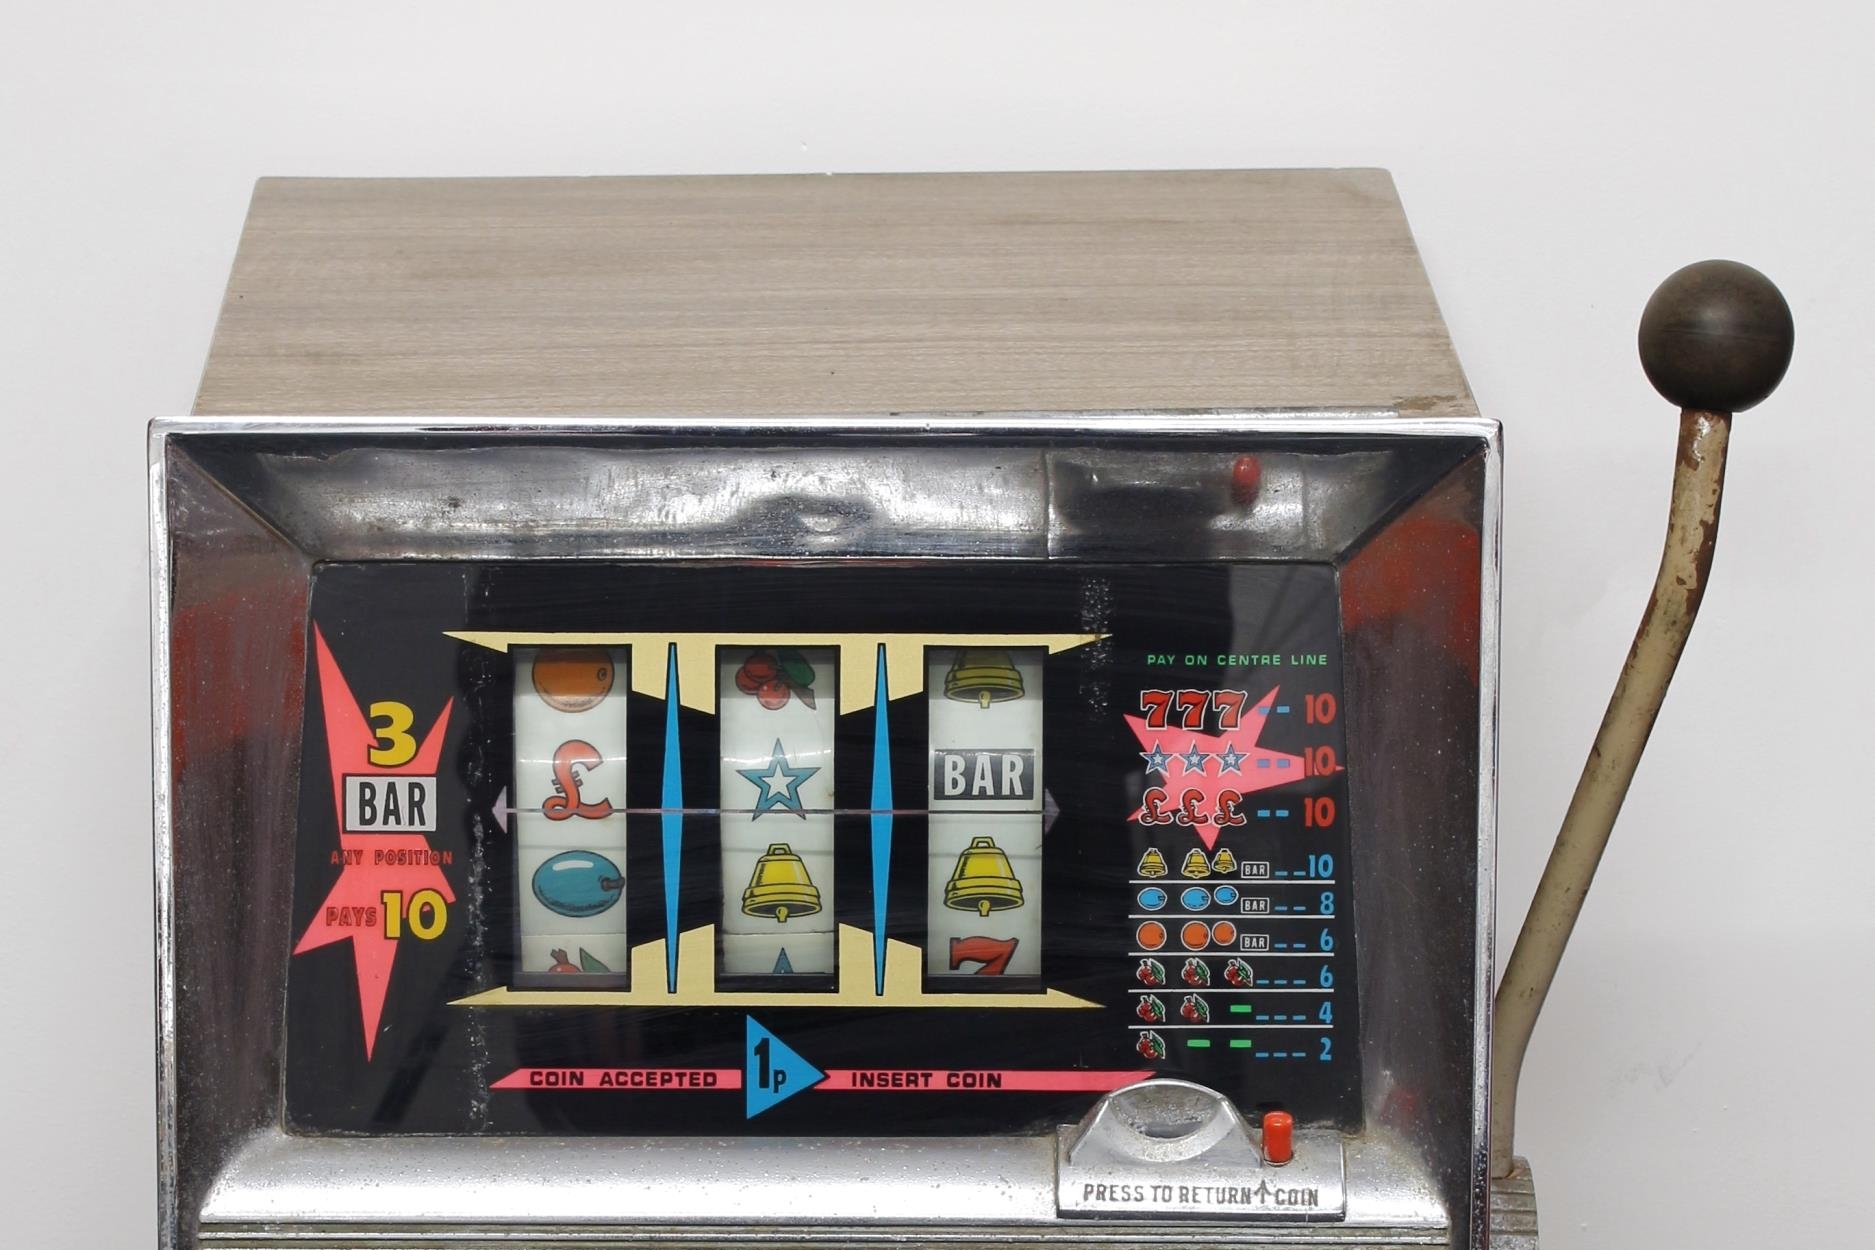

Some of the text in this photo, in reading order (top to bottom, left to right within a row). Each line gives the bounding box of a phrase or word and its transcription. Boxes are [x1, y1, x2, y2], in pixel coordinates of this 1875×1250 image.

[1147, 654, 1328, 666] PAY ON CENTRE LINE
[1305, 693, 1336, 724] 10
[366, 700, 418, 767] 3
[1305, 745, 1336, 776] 10
[944, 754, 1024, 797] BAR
[358, 781, 427, 827] BAR
[1305, 797, 1335, 827] 10
[331, 848, 453, 866] ANY POSITION
[1243, 854, 1333, 878] BAR 10
[325, 887, 449, 941] PAYS 10
[1243, 892, 1334, 914] BAR 8
[1243, 928, 1334, 950] BAR 6
[1320, 965, 1333, 987] 6
[1319, 1001, 1332, 1023] 4
[1320, 1038, 1332, 1060] 2
[752, 1037, 787, 1094] 1p
[529, 1071, 718, 1087] COIN ACCEPTED
[851, 1072, 1002, 1088] INSERT COIN
[1083, 1183, 1320, 1207] PRESS TO RETURN COIN
